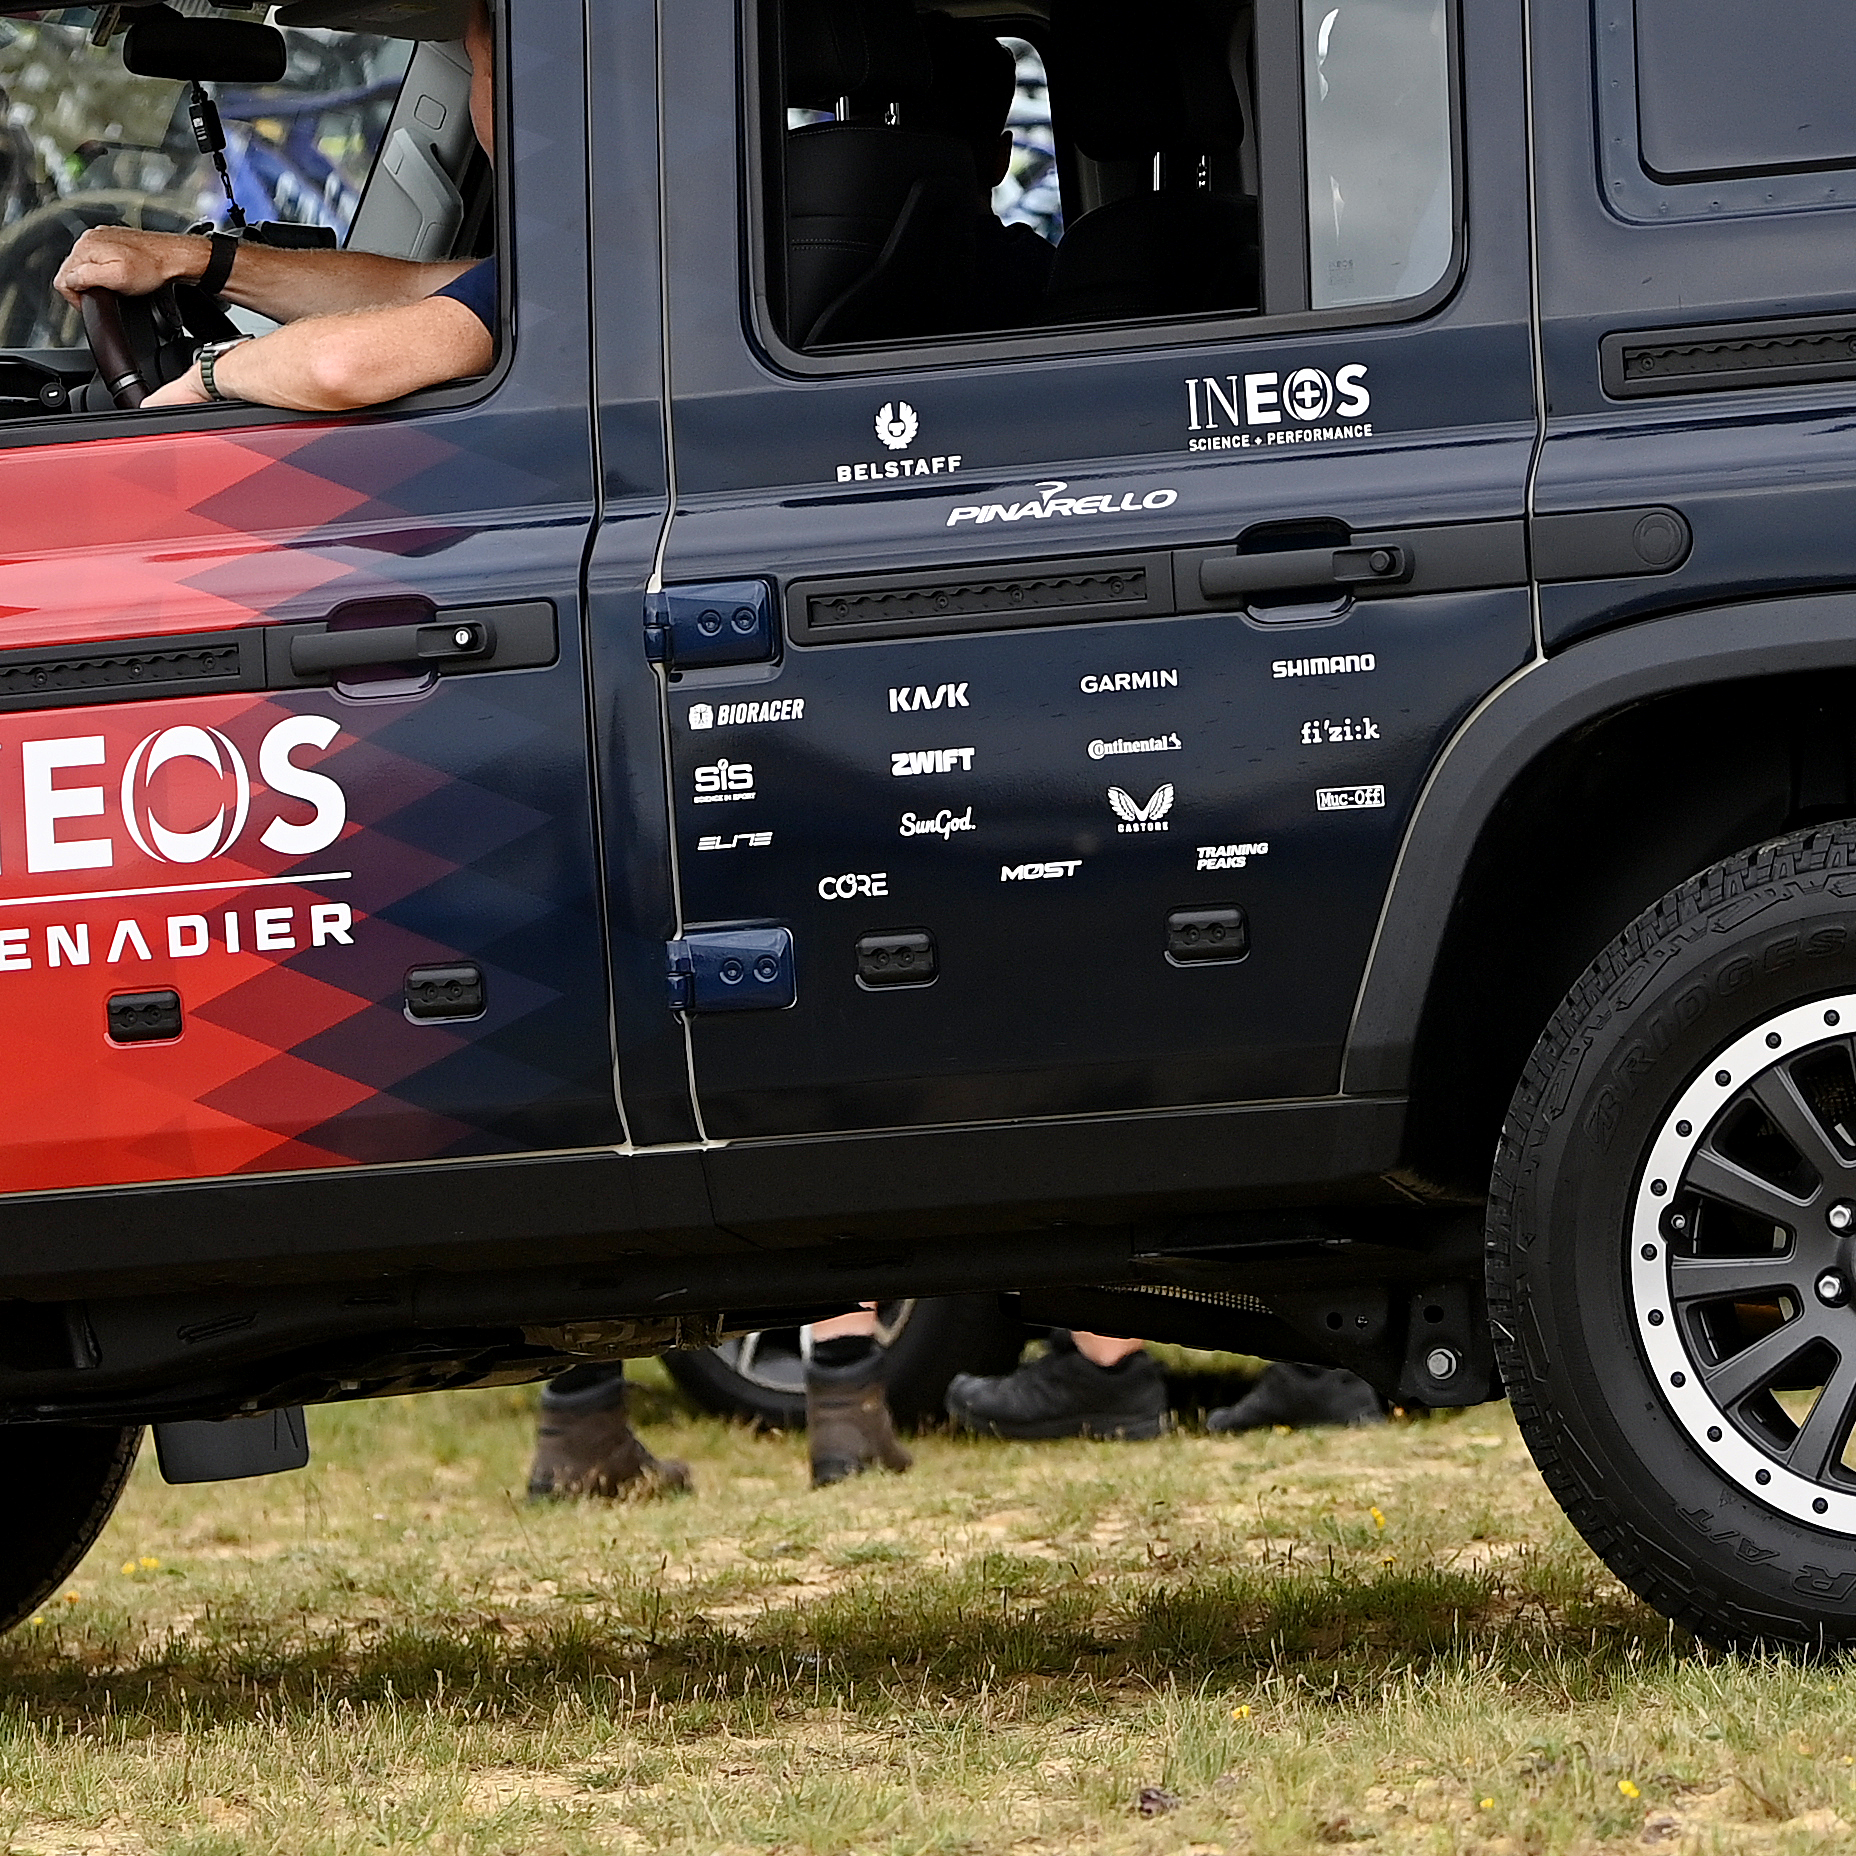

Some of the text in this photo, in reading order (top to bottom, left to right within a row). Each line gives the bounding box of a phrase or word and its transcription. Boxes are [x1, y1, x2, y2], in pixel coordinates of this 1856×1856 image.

[1184, 362, 1373, 432] INEOS
[1188, 433, 1251, 454] SCIENCE
[1266, 422, 1374, 447] PERFORMANCE
[835, 454, 964, 484] BELSTAFF
[945, 480, 1180, 528] PINARELLO
[1271, 652, 1377, 680] SHIMANO
[1079, 668, 1180, 695] GARMIN
[888, 681, 971, 713] KASK
[716, 697, 806, 727] BIORACER
[890, 746, 976, 778] ZWIFT
[1086, 734, 1171, 761] Continental
[1318, 786, 1383, 809] Muc-Off
[696, 830, 774, 852] ELITE
[1116, 820, 1170, 834] CASTORE
[1195, 841, 1270, 859] TRAINING
[1195, 855, 1248, 872] PEAKS
[817, 871, 890, 901] CORE
